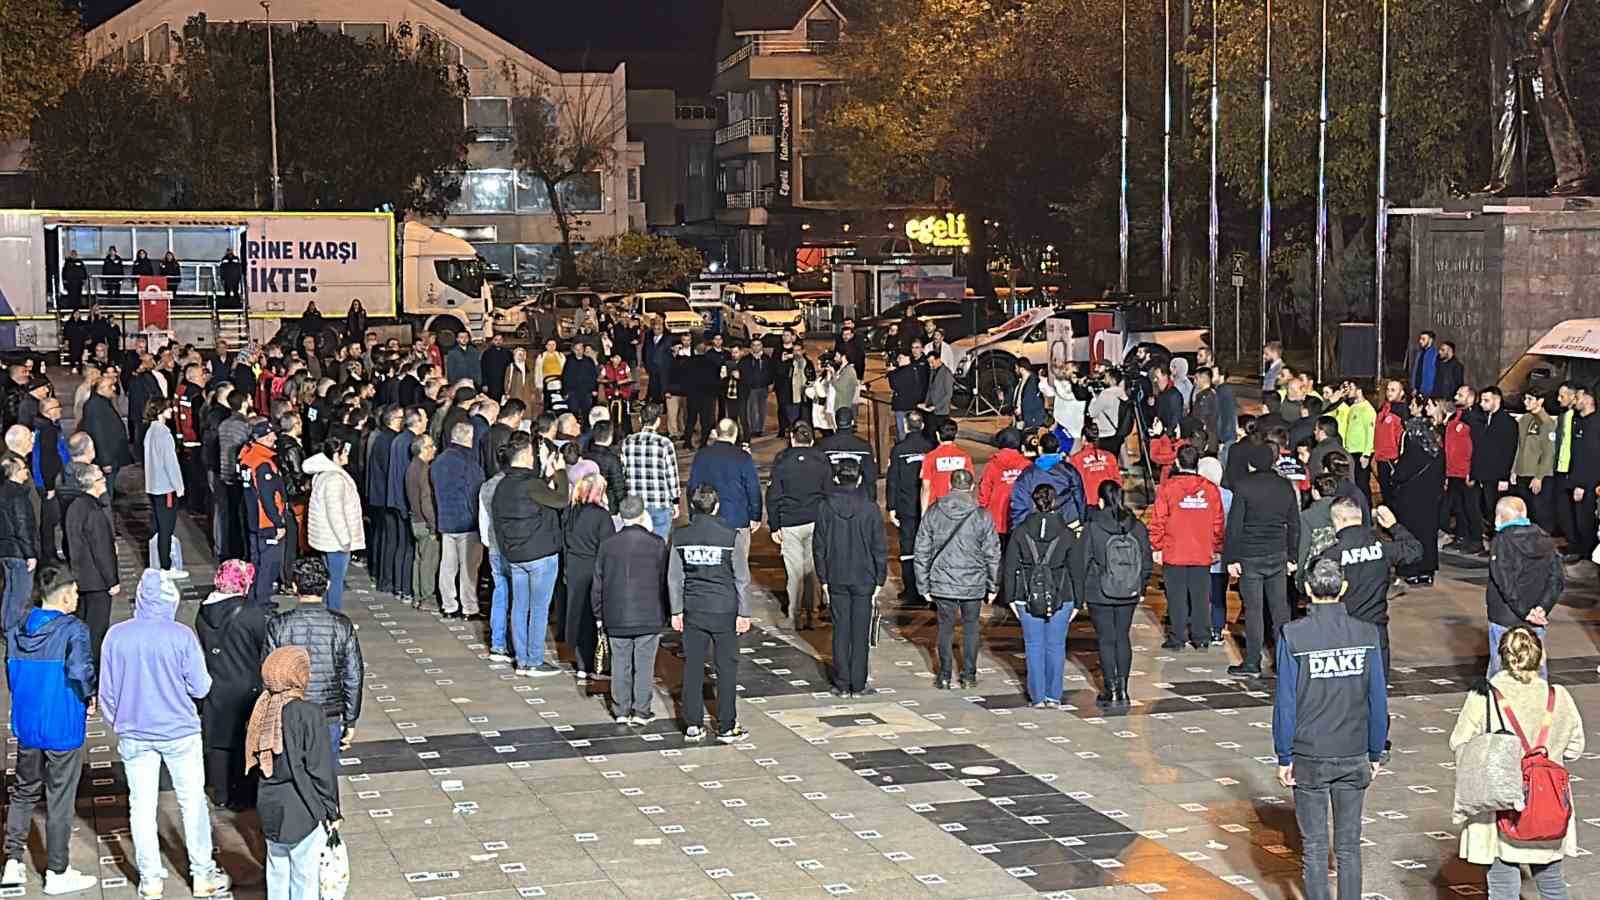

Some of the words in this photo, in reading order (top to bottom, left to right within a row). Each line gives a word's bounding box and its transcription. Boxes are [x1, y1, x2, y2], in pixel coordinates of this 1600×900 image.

[905, 213, 968, 244] egeli
[248, 236, 293, 259] RİNE
[299, 241, 357, 264] KARŞI
[251, 260, 318, 293] İKTE!
[1341, 543, 1383, 566] AFAD
[1309, 655, 1365, 673] DAKE
